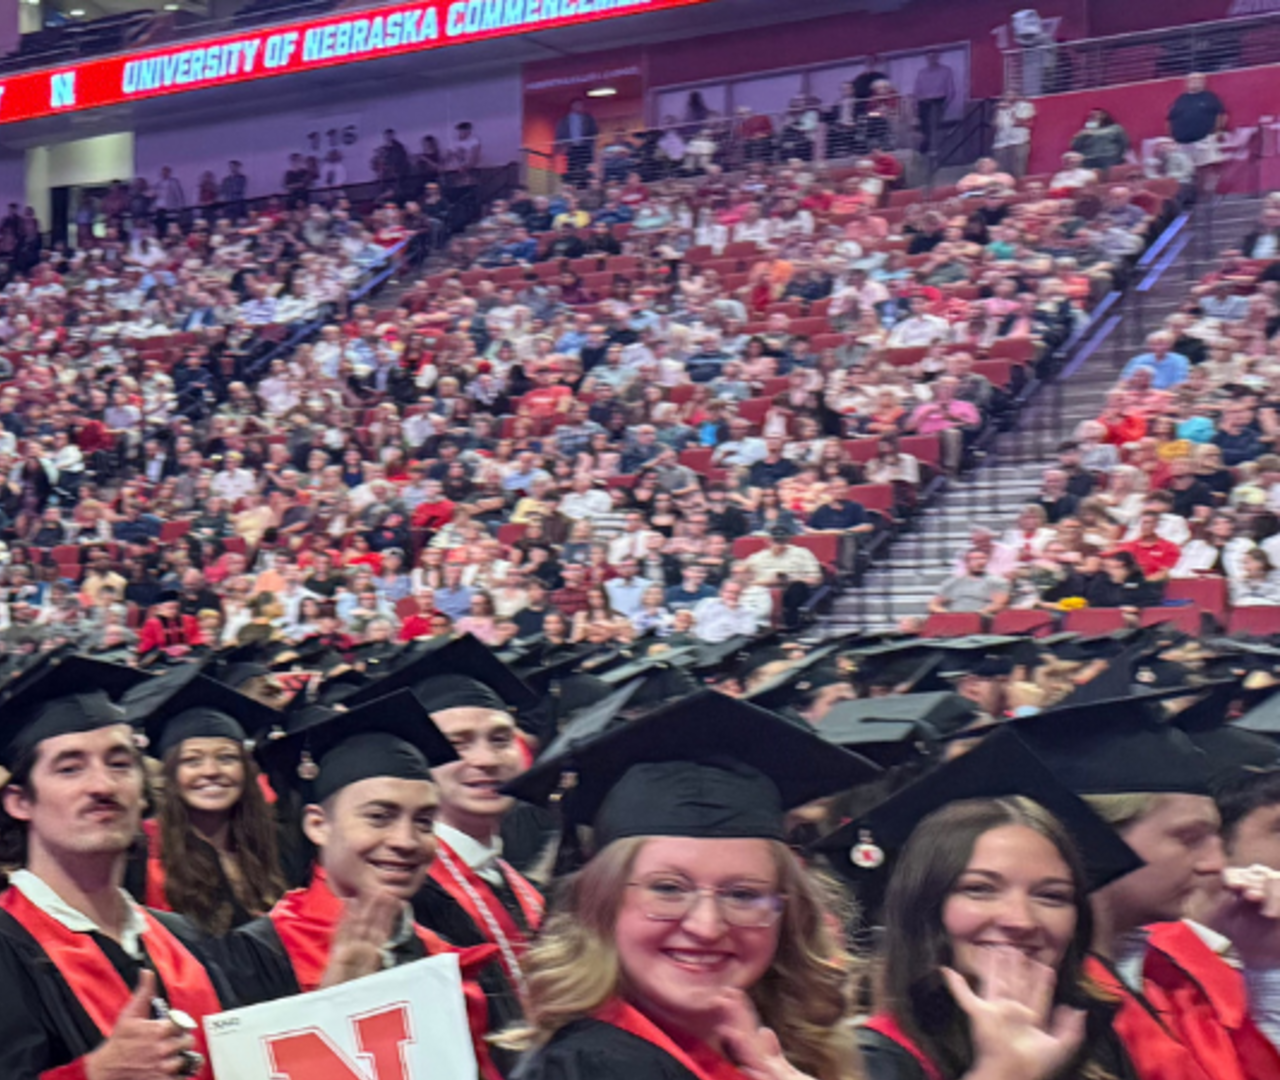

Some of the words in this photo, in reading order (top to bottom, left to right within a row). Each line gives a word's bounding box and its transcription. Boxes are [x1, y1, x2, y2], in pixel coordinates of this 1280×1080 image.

[121, 39, 260, 93] UNIVERSITY
[264, 32, 299, 67] OF
[302, 7, 438, 61] NEBRASKA
[445, 0, 651, 36] COMMEN
[51, 72, 76, 107] N
